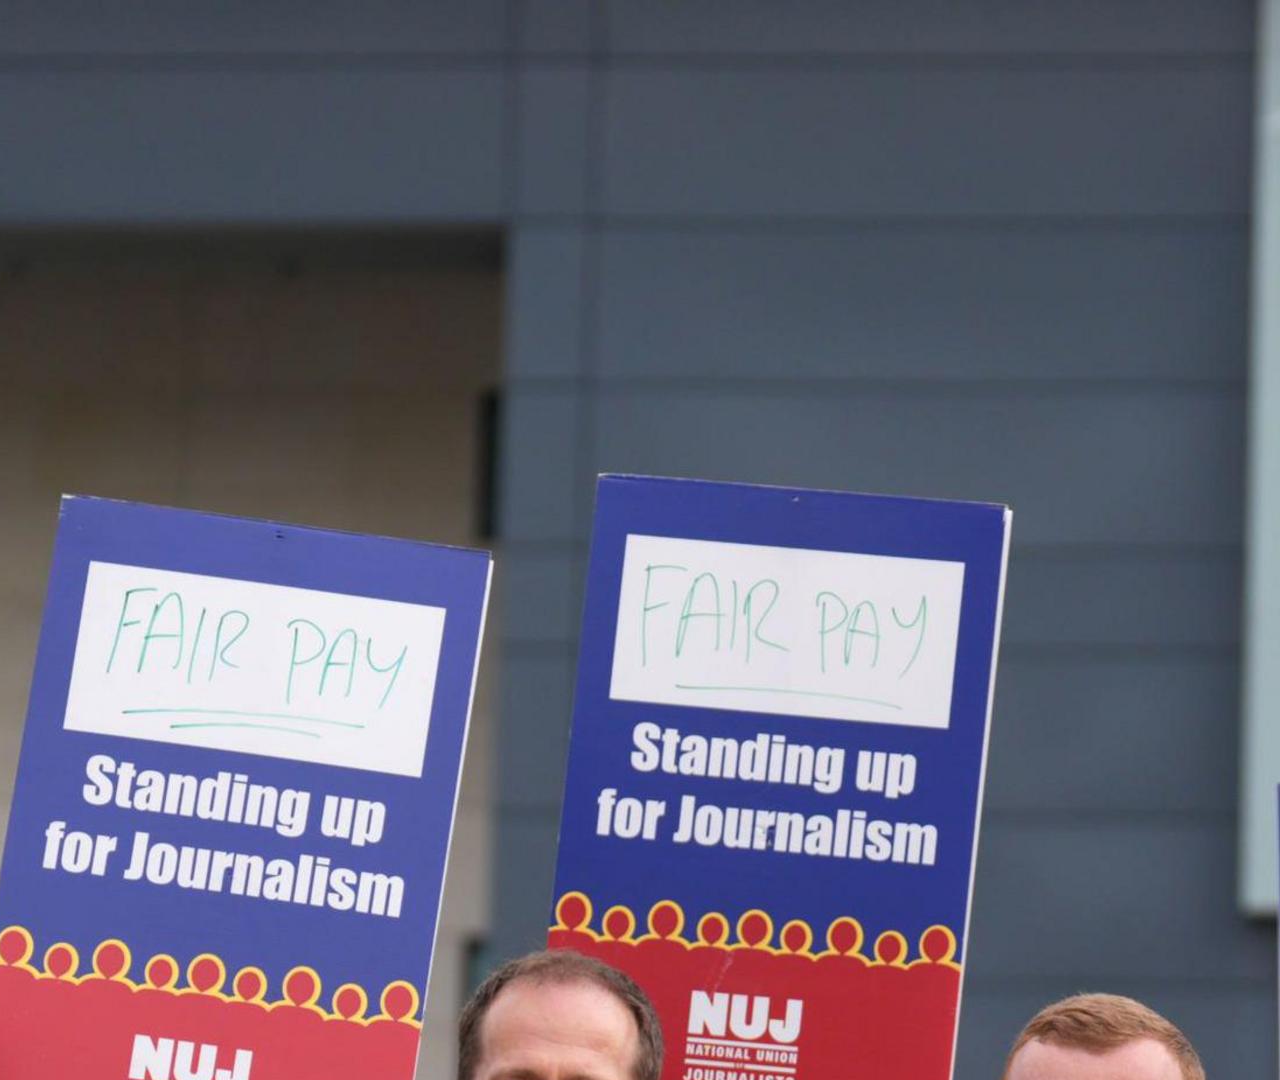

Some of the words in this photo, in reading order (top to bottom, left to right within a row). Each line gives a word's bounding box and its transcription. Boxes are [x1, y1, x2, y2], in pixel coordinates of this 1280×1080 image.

[106, 587, 250, 684] FAIR
[287, 619, 408, 709] PAY
[640, 565, 790, 667] FAIR
[816, 591, 926, 680] PAY
[82, 754, 311, 838] Standing
[321, 794, 387, 847] up
[630, 721, 846, 794] Standing
[855, 750, 917, 799] up
[42, 820, 118, 876] for
[123, 831, 405, 918] Journalism
[596, 788, 666, 840] for
[672, 794, 939, 866] Journalism
[685, 1043, 751, 1060] NATIONAL
[756, 1049, 798, 1065] UNION
[688, 989, 803, 1043] NUJ
